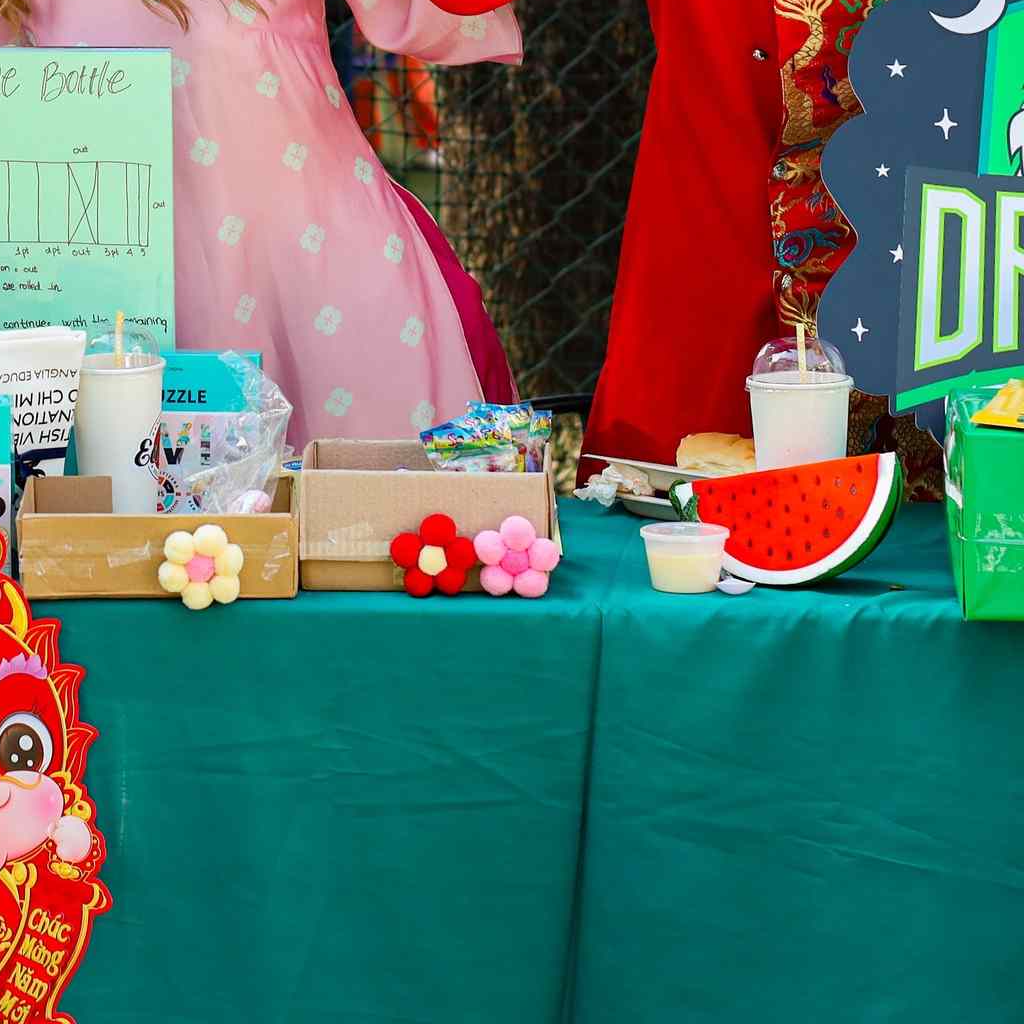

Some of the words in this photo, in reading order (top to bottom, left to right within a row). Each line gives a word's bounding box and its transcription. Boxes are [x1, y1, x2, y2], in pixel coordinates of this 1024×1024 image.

[40, 60, 133, 103] Bottle
[72, 145, 88, 154] out
[71, 247, 93, 257] out
[61, 315, 89, 328] with
[35, 368, 78, 379] ANGLIA
[38, 389, 64, 405] CHI
[162, 389, 207, 404] ZZLE
[13, 409, 75, 426] NATION
[28, 908, 72, 943] Chúc
[18, 933, 65, 977] Mừng
[7, 962, 49, 1003] Năm
